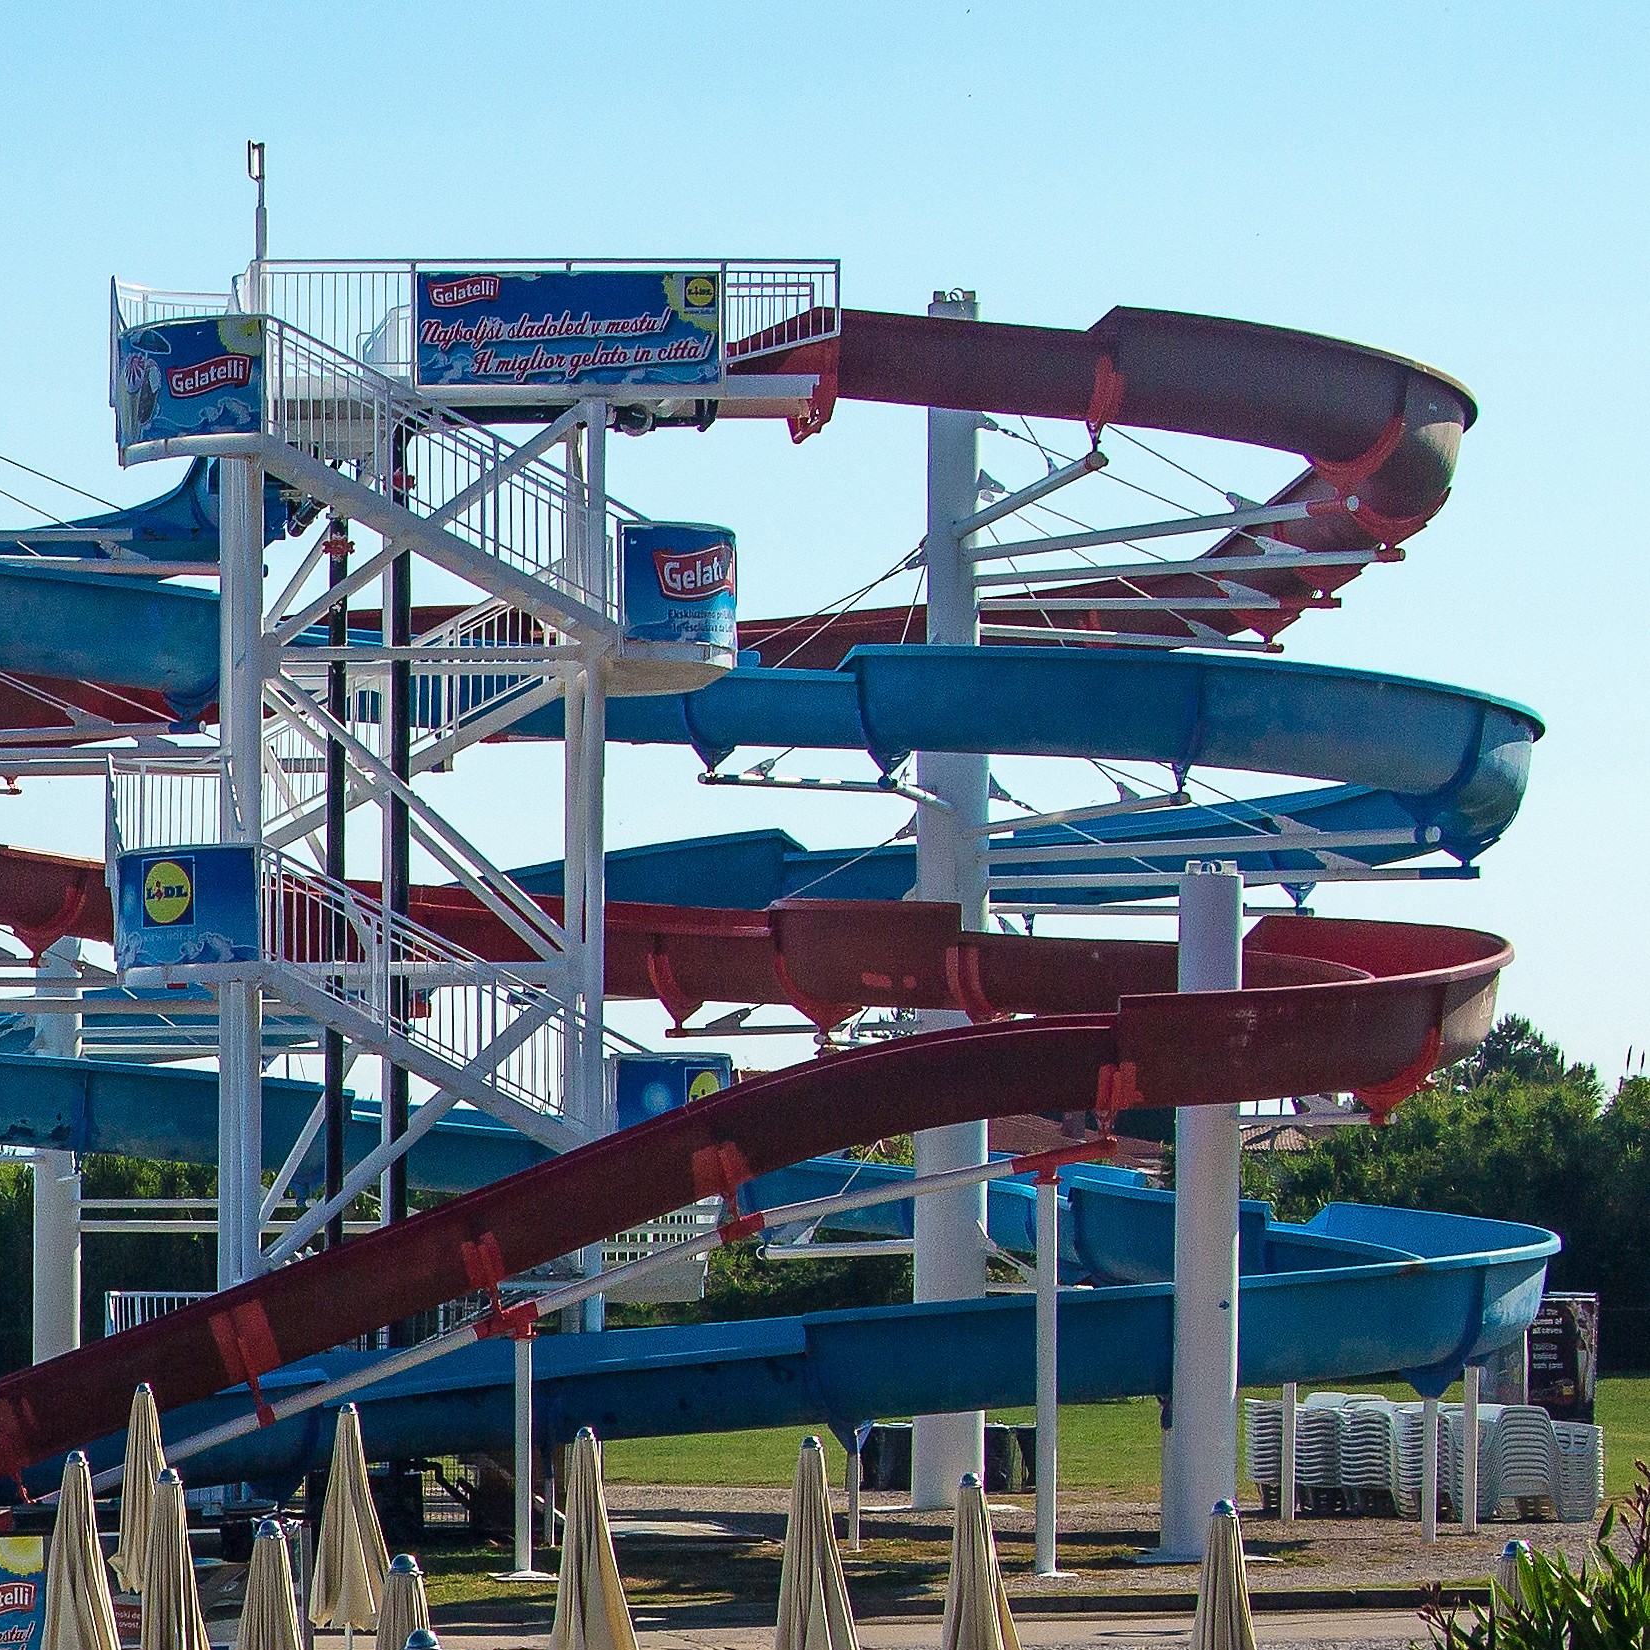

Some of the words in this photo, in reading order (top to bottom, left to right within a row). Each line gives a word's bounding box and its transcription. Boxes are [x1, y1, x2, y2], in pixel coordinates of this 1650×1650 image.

[432, 279, 495, 304] Gelatelli
[422, 316, 502, 349] Najboljši
[507, 312, 589, 338] sladoled
[591, 323, 602, 336] v
[605, 308, 670, 334] mestu!
[495, 345, 565, 379] miglior
[569, 342, 628, 376] gelato
[633, 349, 651, 362] in
[658, 335, 714, 361] città!
[172, 360, 244, 391] Gelatelli
[663, 556, 725, 591] Gelat
[146, 880, 188, 900] LIDL
